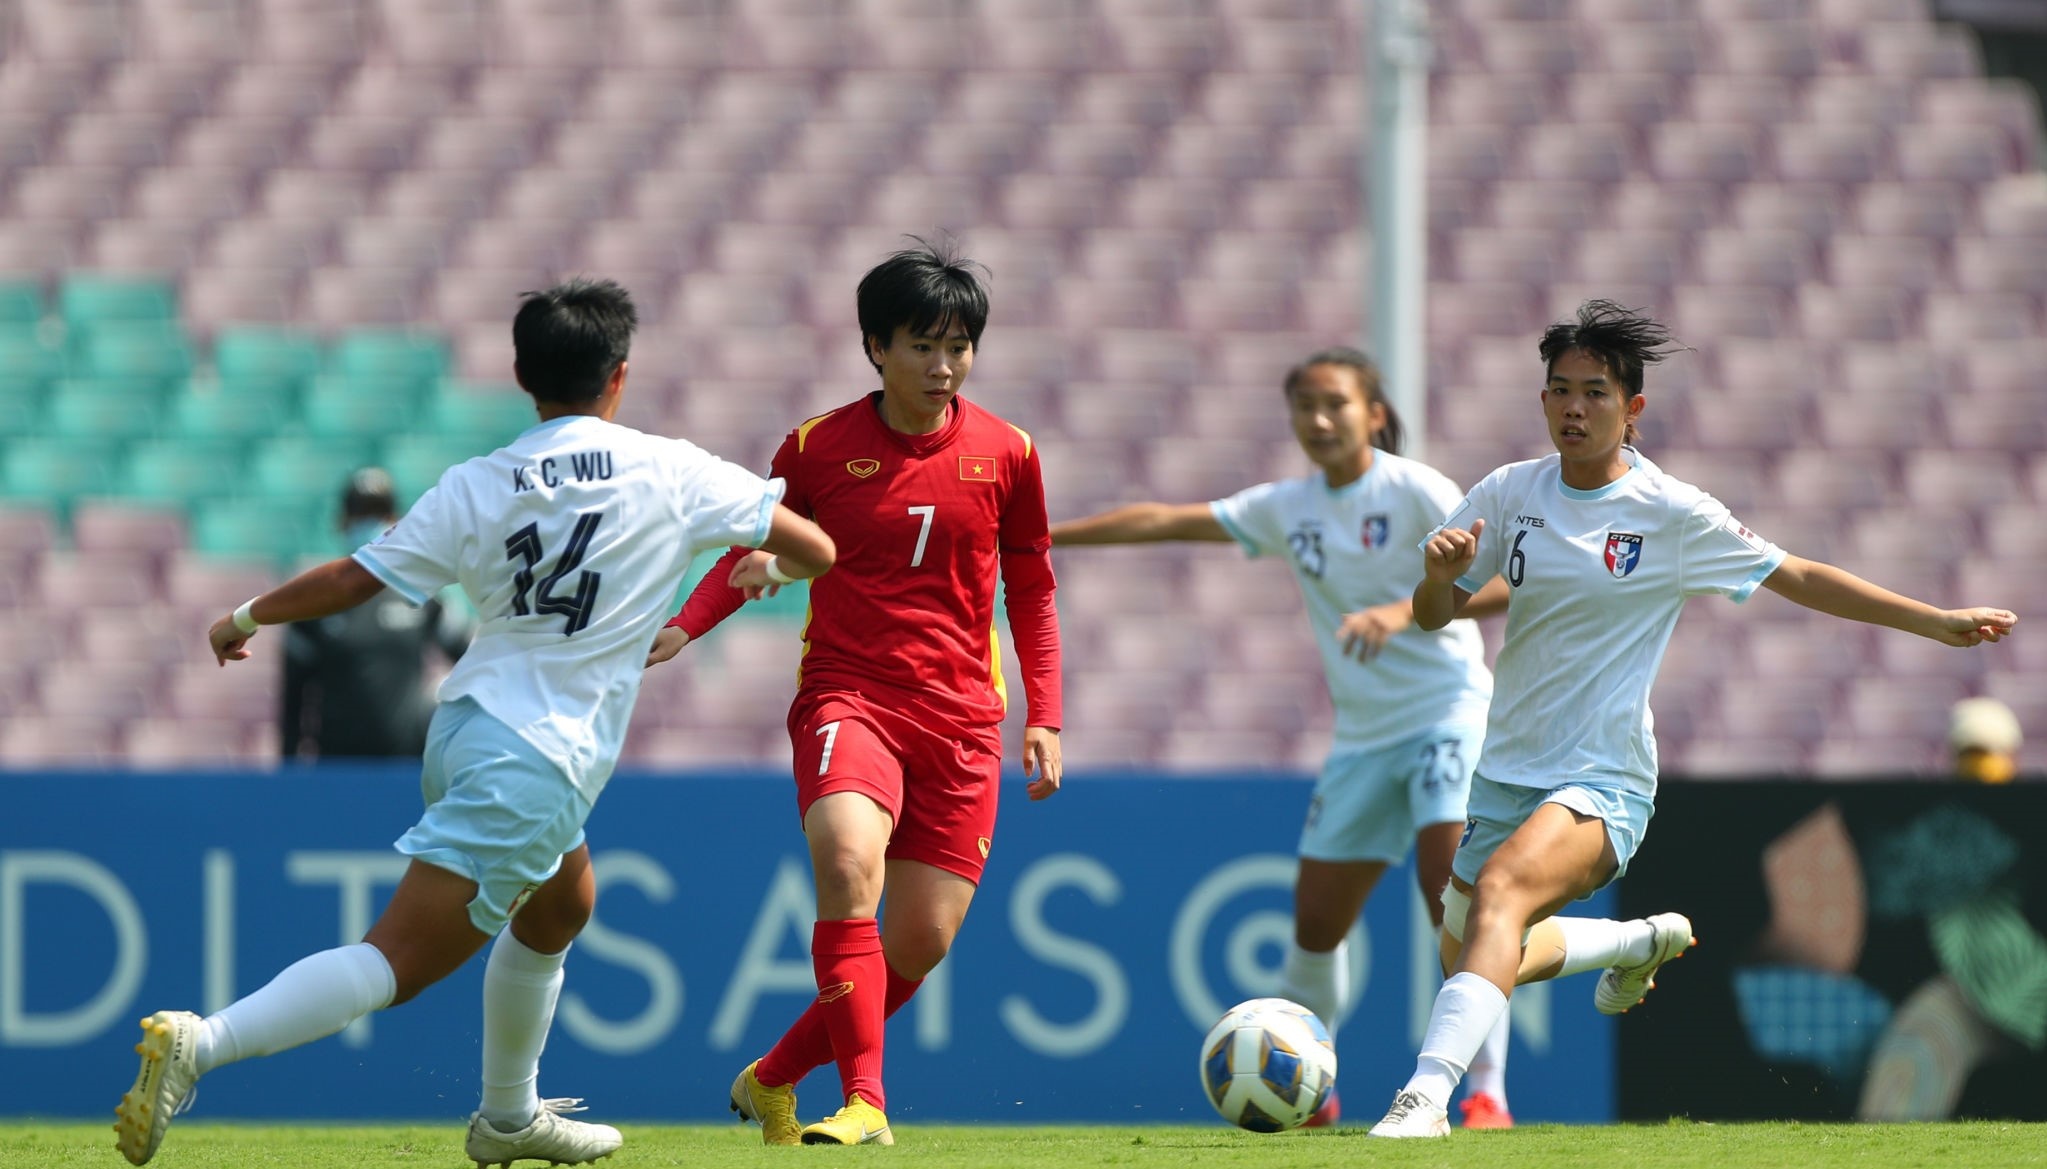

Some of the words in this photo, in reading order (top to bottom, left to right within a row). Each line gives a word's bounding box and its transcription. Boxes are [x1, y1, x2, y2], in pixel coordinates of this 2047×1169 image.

[514, 467, 534, 493] K.
[541, 457, 564, 488] C.
[572, 450, 613, 483] WU
[907, 505, 936, 567] 7
[1288, 527, 1327, 580] 23
[1509, 529, 1528, 588] 6
[1610, 534, 1640, 544] CTFA
[505, 512, 604, 637] 14
[815, 720, 841, 776] 7
[1419, 739, 1465, 791] 23
